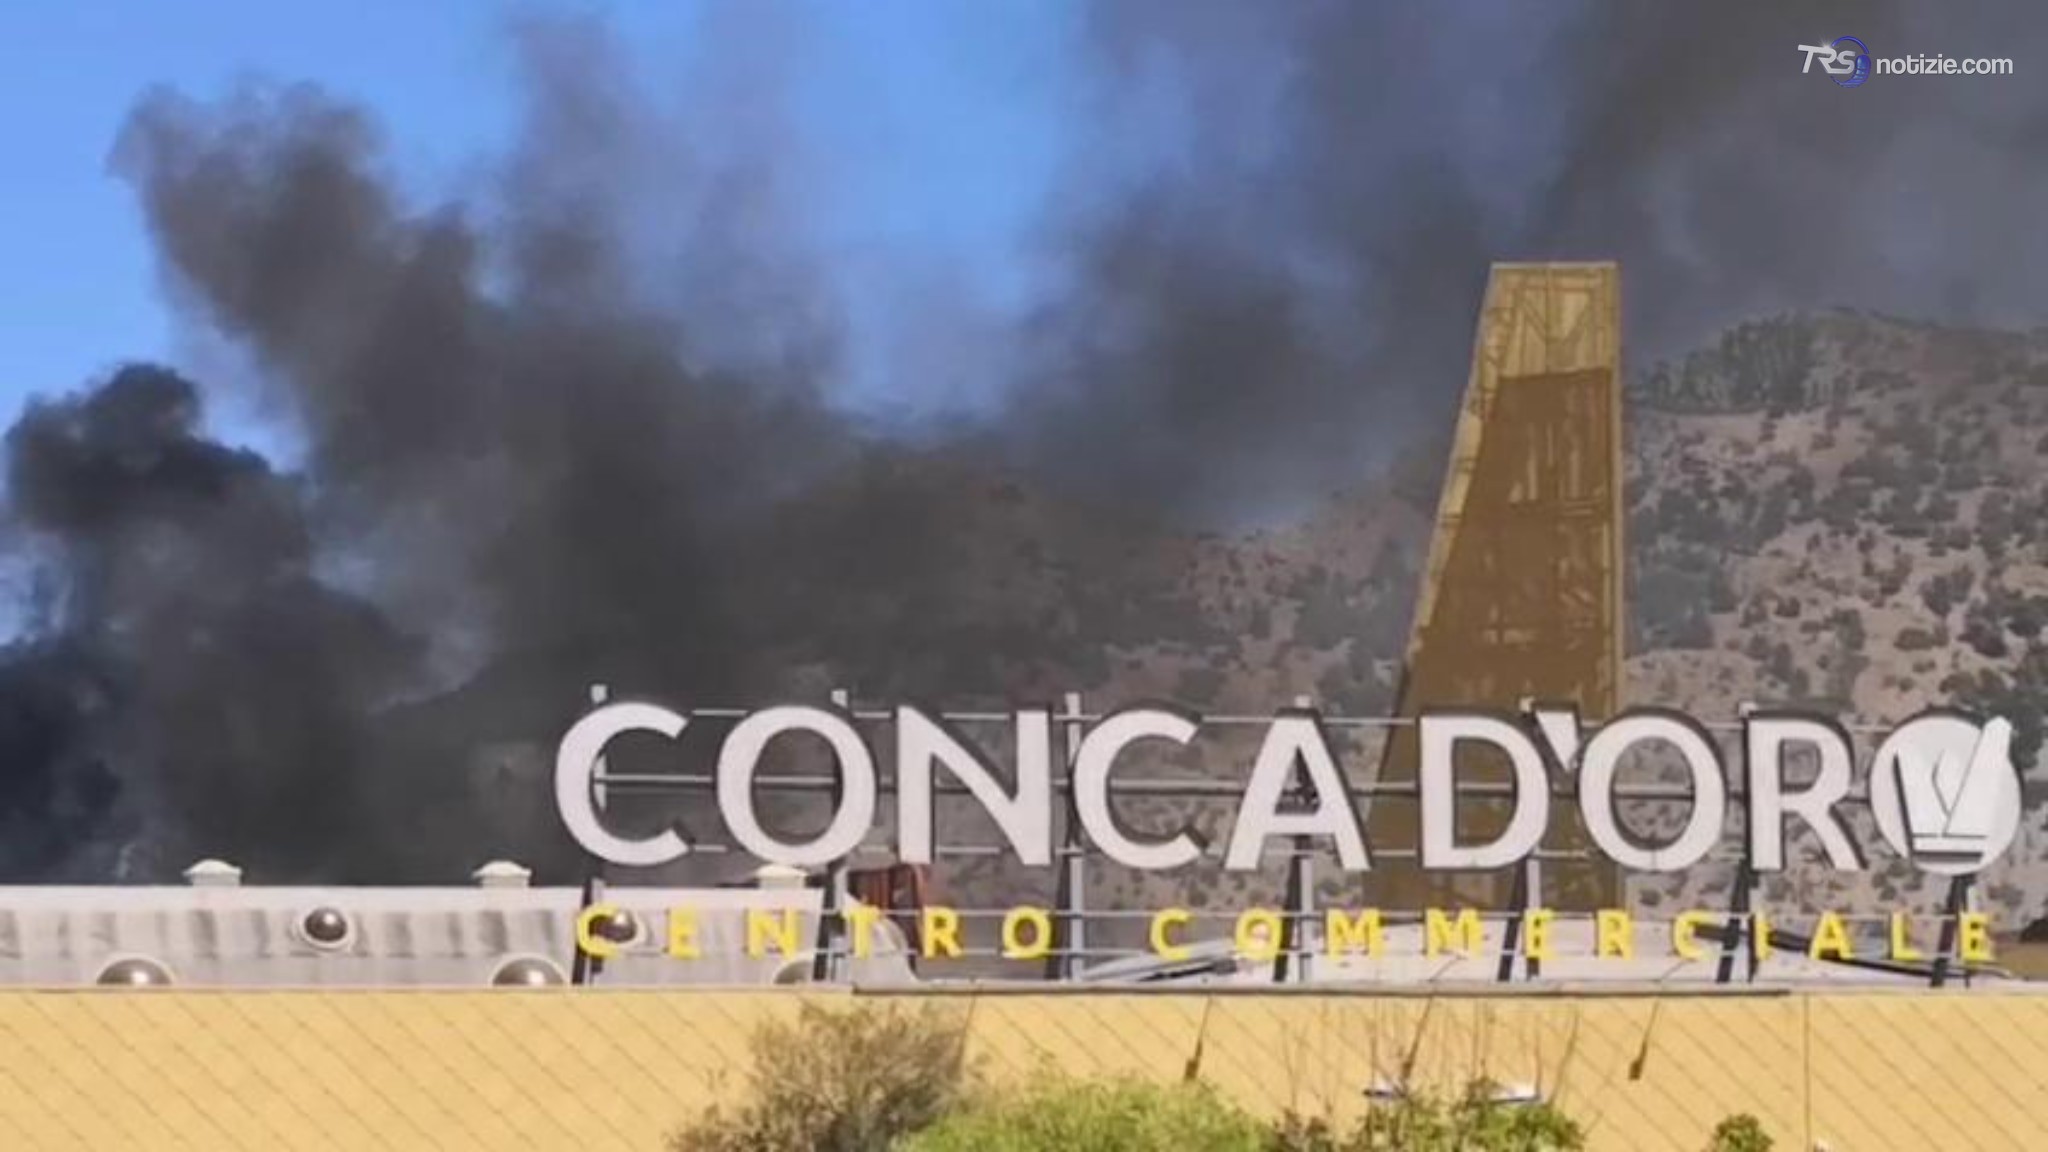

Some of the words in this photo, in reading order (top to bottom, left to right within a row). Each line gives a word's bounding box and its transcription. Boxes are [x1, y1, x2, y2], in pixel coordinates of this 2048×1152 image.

[555, 702, 1370, 871] CONCA
[576, 903, 1053, 960] CENTRO
[1149, 904, 1997, 964] COMMERCIALE
